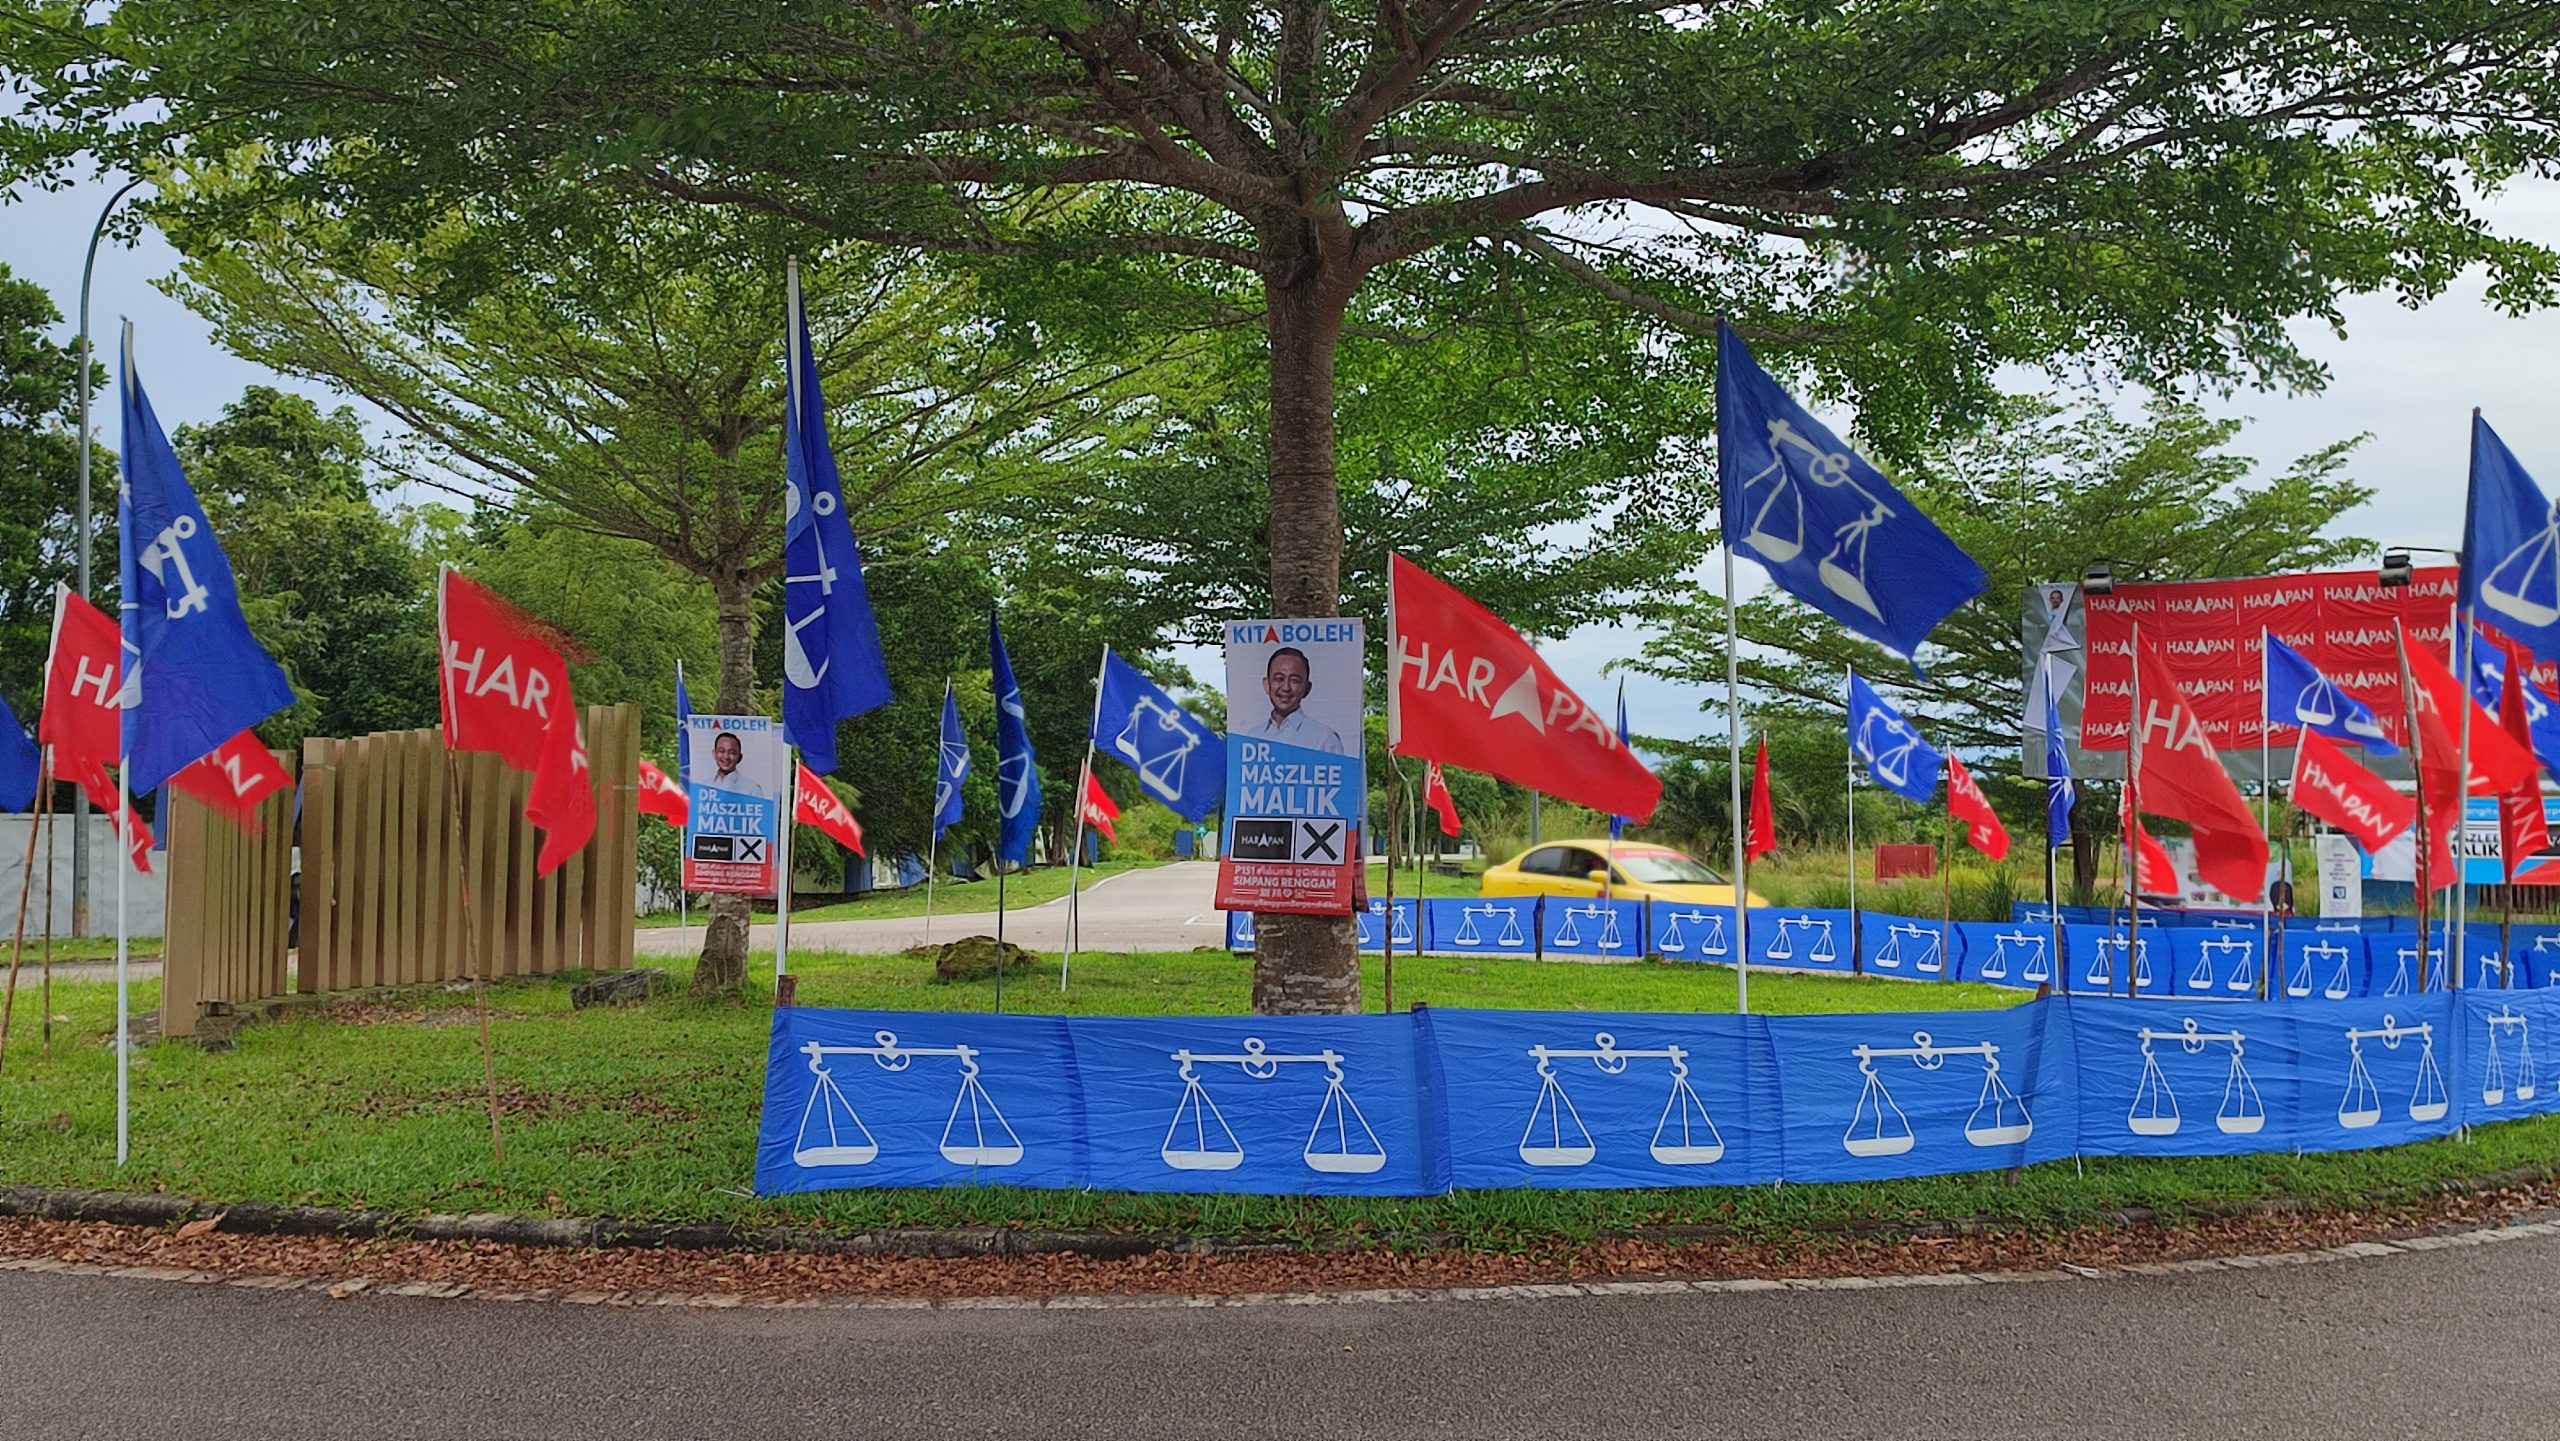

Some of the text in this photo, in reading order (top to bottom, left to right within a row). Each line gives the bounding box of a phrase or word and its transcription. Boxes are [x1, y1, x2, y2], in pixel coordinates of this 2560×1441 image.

[2243, 588, 2314, 609] HARAPAN
[2324, 584, 2397, 603] HARAPAN
[2090, 597, 2156, 614] HARAPAN
[2166, 596, 2233, 614] HARAPAN
[2167, 637, 2235, 655] HARAPAN
[2176, 678, 2234, 696] ARAPAN
[1241, 743, 1276, 763] DR.
[1240, 765, 1342, 786] MASZLEE
[699, 788, 720, 802] DR.
[1239, 787, 1340, 816] MALIK
[698, 802, 764, 817] MASZLEE
[697, 815, 763, 835] MALIK
[1233, 875, 1337, 889] SIMPANG RENGGAM
